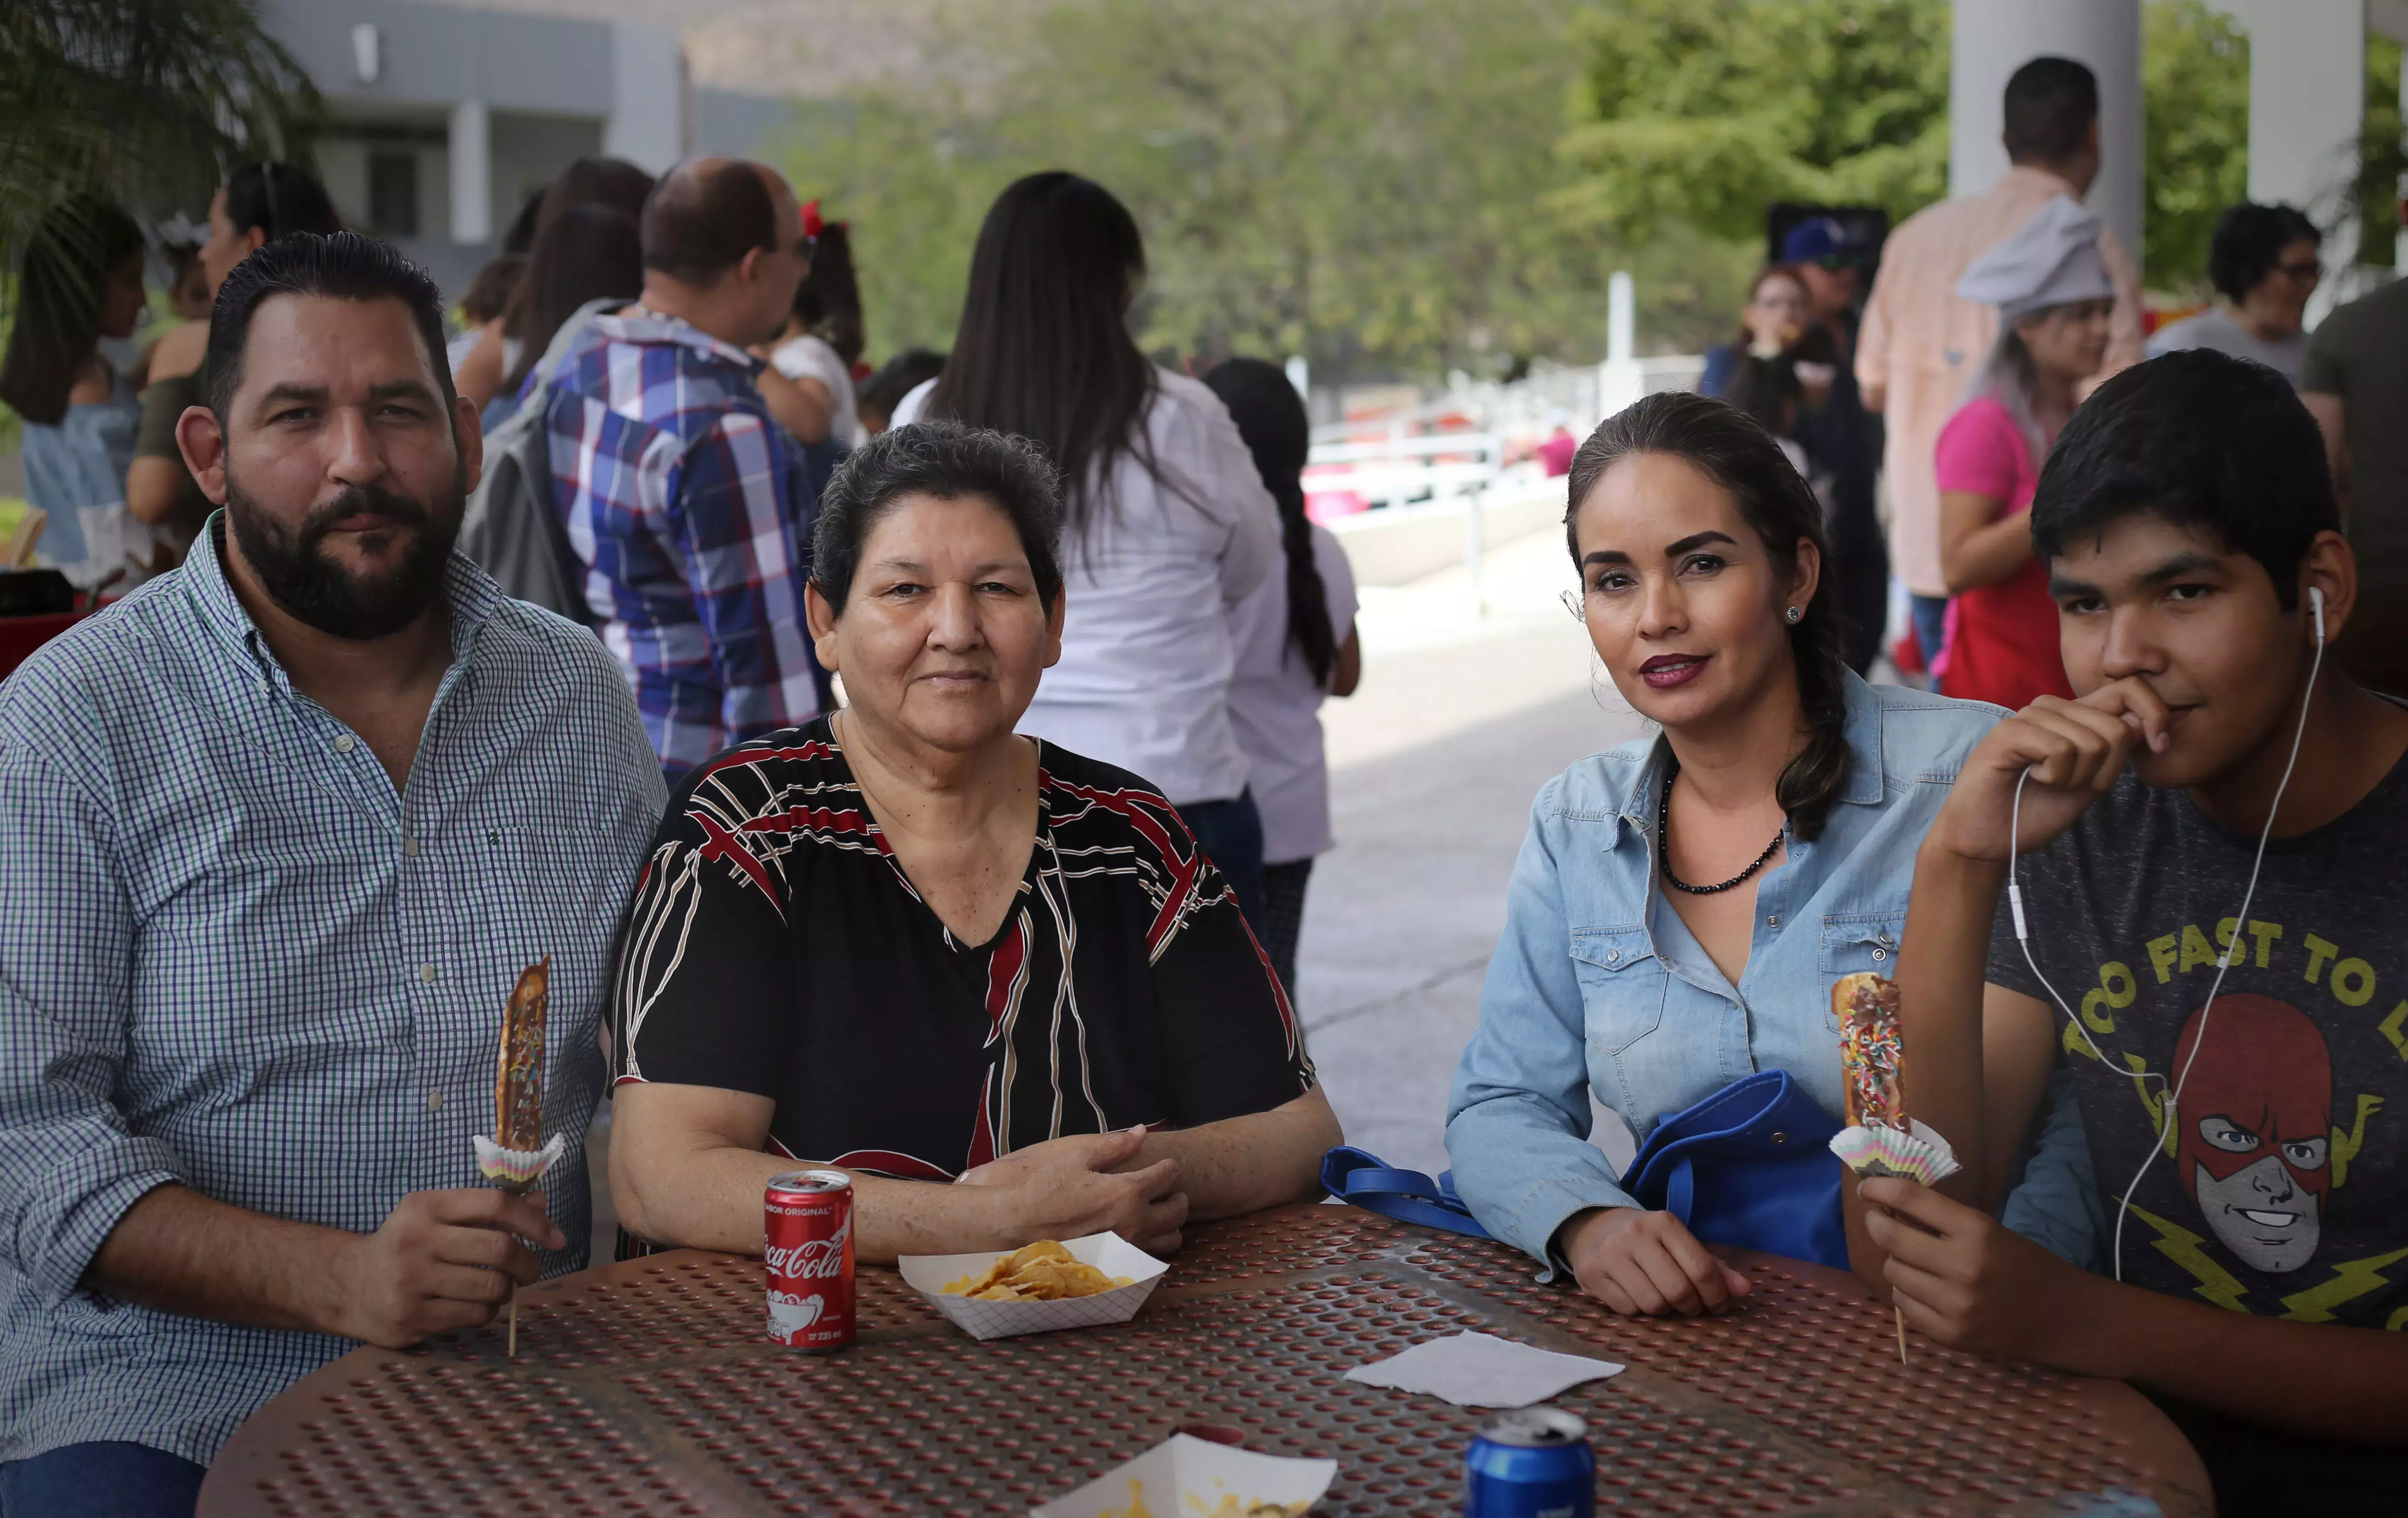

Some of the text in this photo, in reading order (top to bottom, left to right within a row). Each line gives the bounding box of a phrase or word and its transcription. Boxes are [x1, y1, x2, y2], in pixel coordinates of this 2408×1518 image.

[2062, 916, 2408, 1063] TOO FAST TO L
[764, 1201, 830, 1216] ABOR ORIGINAL
[764, 1233, 843, 1279] oca-Cola
[818, 1332, 832, 1341] 235
[833, 1329, 842, 1339] ml
